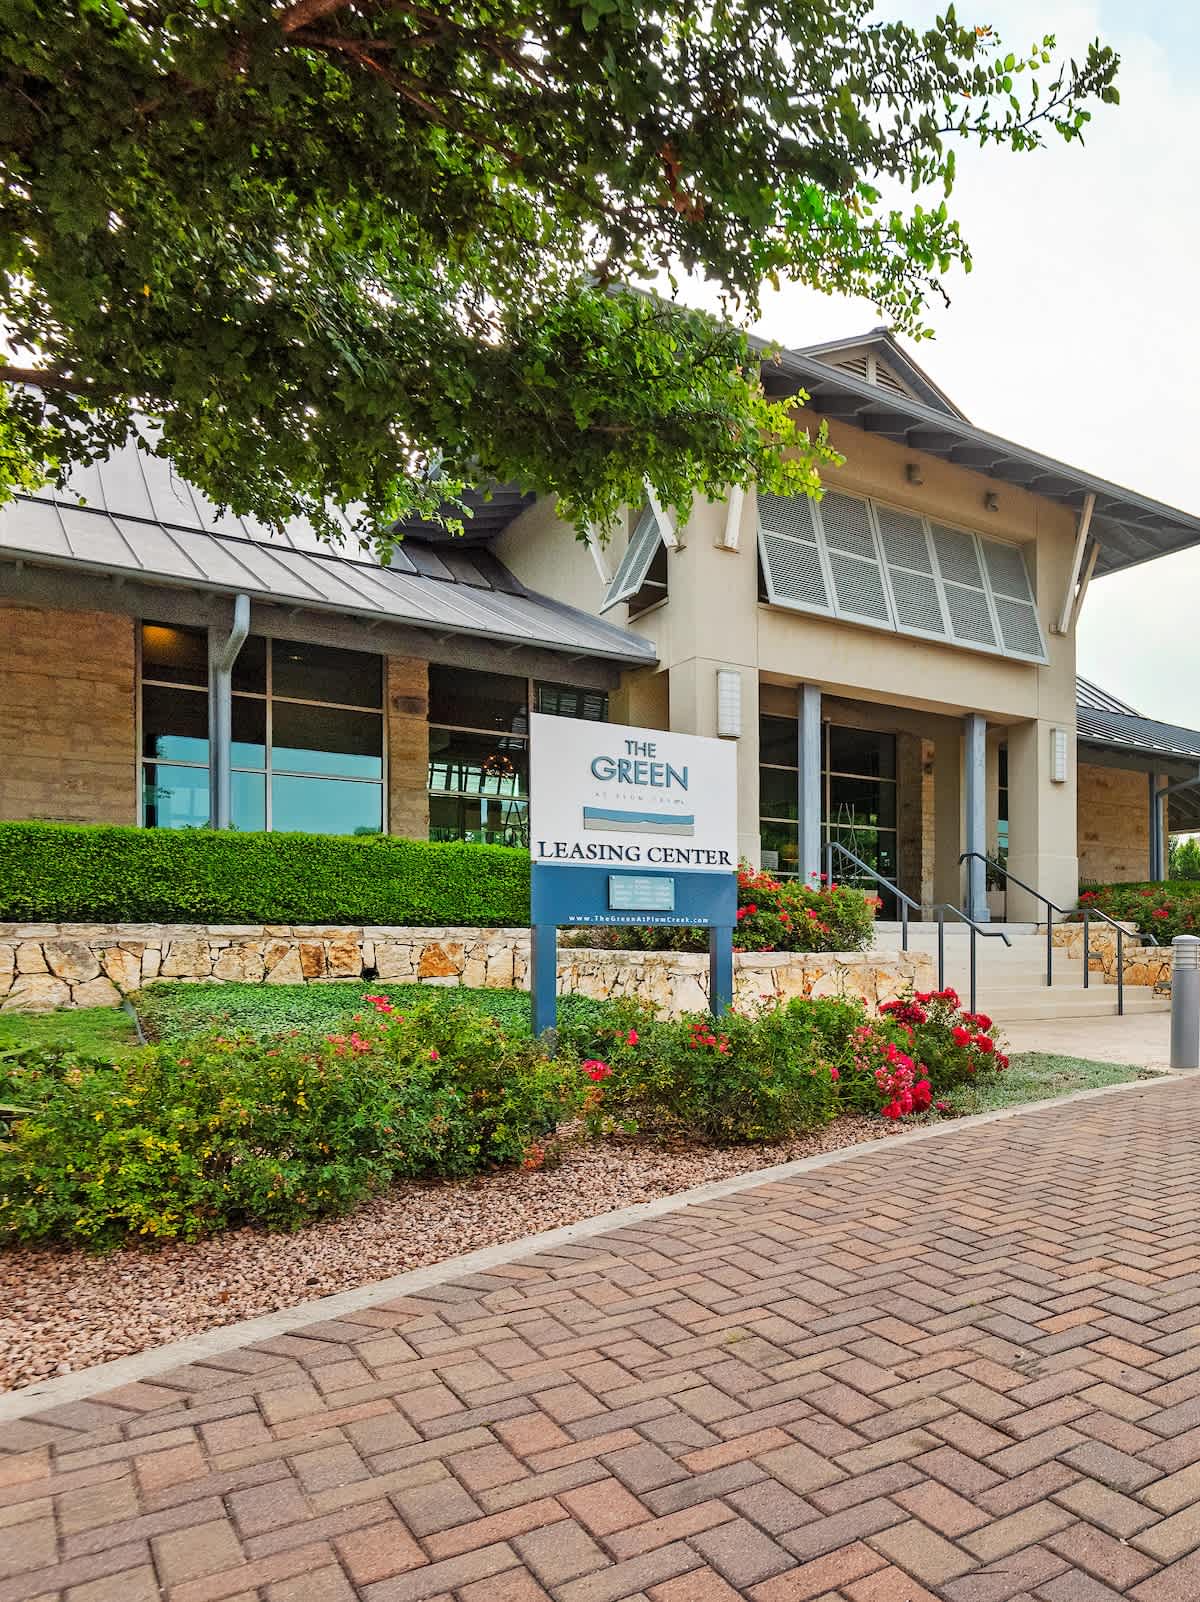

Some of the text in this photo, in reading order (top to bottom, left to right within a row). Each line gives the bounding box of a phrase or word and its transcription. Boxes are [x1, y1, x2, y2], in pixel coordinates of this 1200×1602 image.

[625, 740, 656, 758] THE
[591, 756, 688, 791] GREEN
[537, 841, 732, 866] LEASING CENTER
